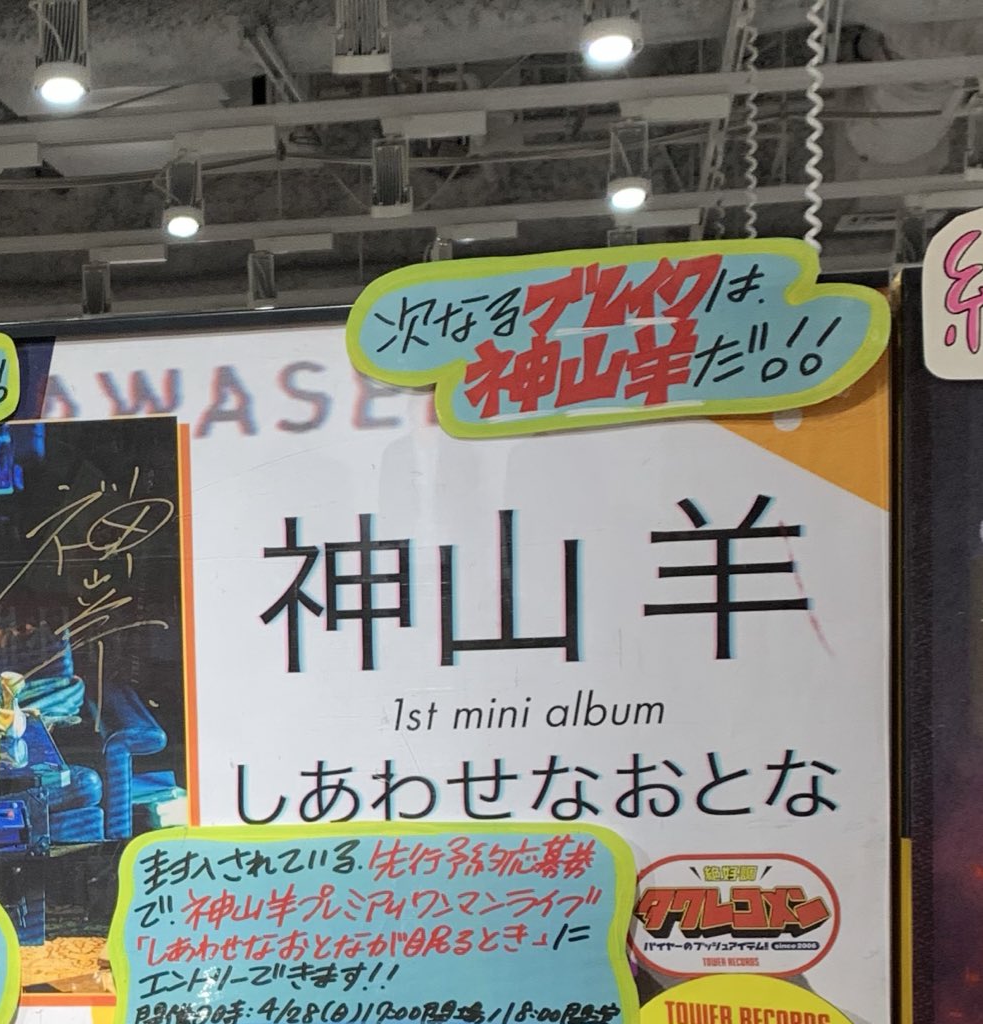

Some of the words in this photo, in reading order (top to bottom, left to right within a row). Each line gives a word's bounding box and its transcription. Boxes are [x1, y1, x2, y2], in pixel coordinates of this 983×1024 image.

[42, 361, 439, 439] AWASE
[260, 494, 809, 672] 神山羊
[394, 697, 438, 731] 1st
[453, 697, 529, 730] mini
[546, 690, 666, 728] album
[236, 749, 839, 825] しあわせなおとな
[634, 886, 832, 938] タワレコメン
[702, 957, 727, 967] TOWER
[728, 957, 759, 967] RECORDS
